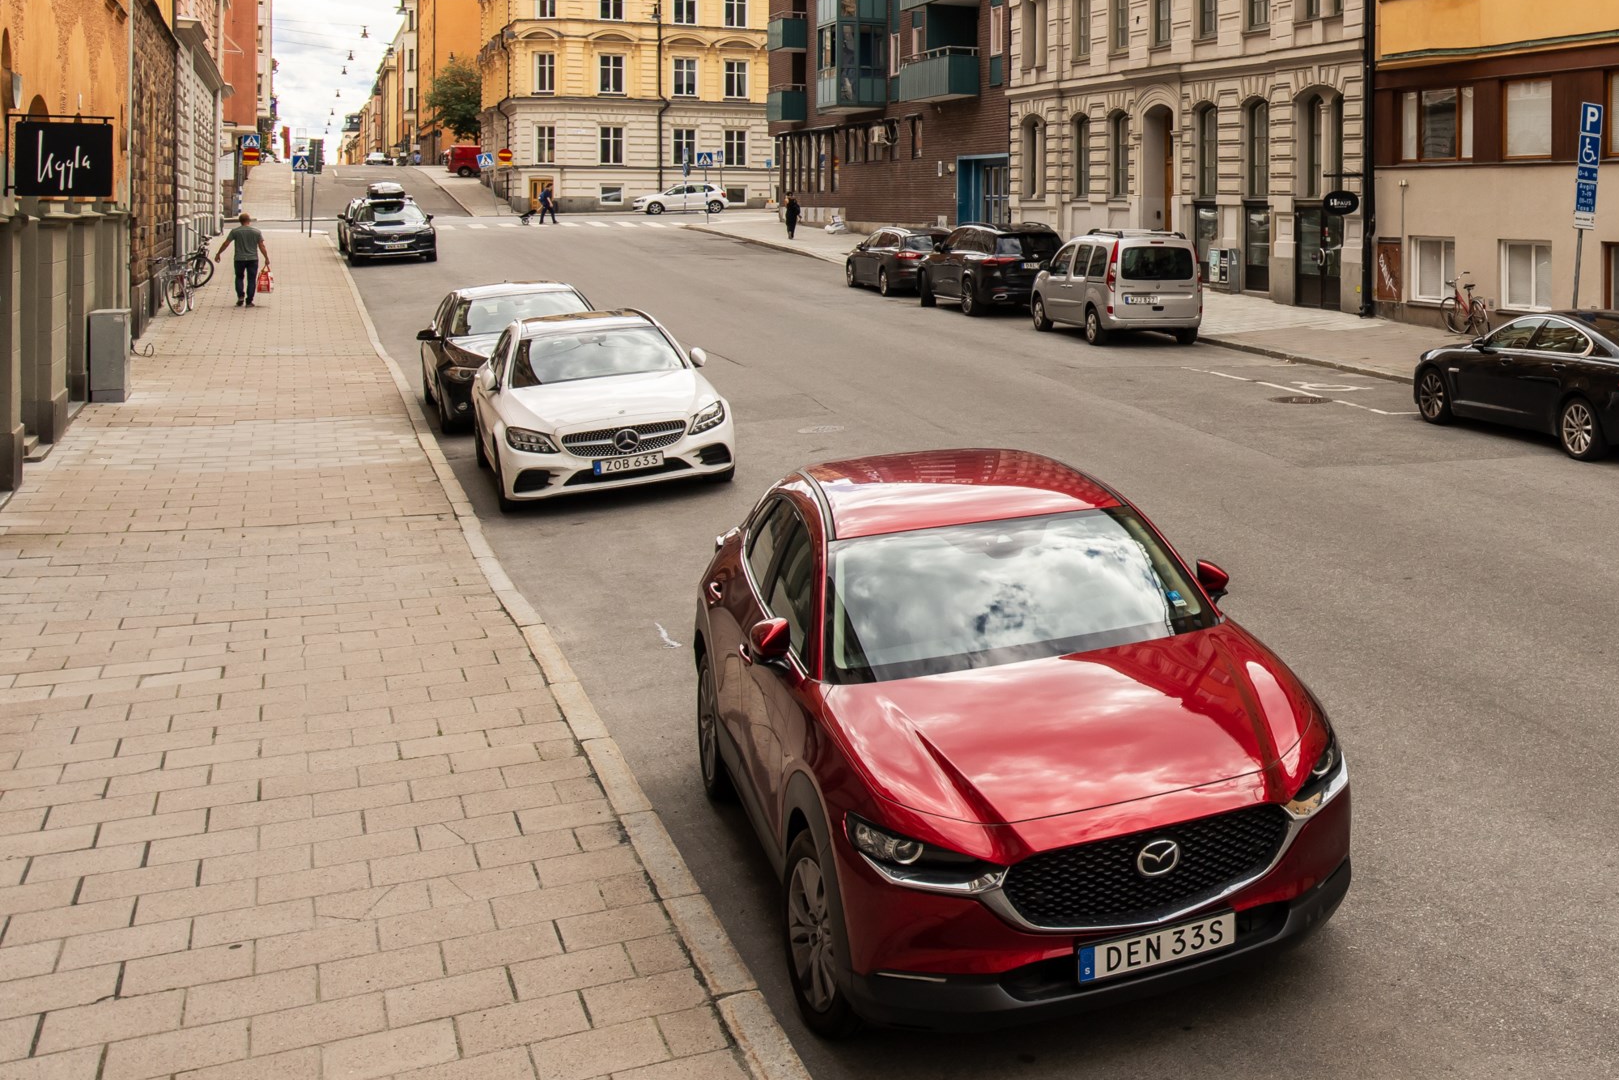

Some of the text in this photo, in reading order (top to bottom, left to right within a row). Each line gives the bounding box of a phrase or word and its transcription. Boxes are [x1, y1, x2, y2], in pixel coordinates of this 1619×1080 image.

[1586, 106, 1599, 131] P
[605, 454, 658, 471] ZOB 633
[1106, 919, 1224, 973] DEN 33S
[1084, 967, 1091, 975] S
